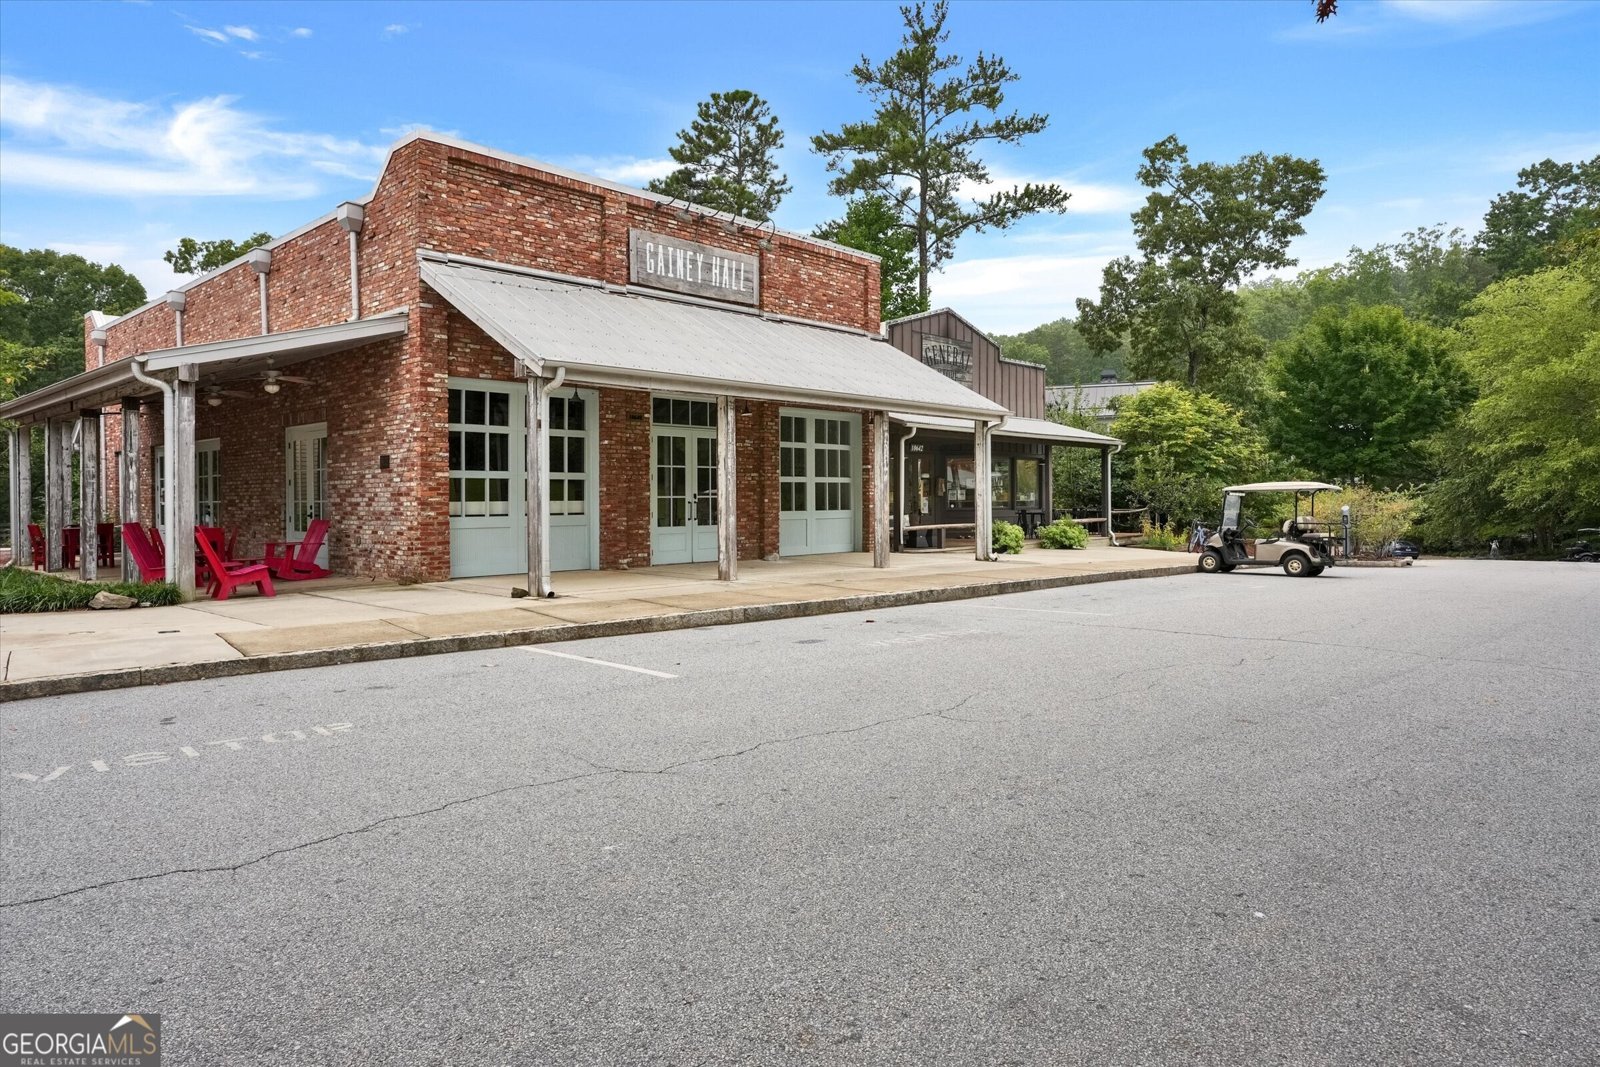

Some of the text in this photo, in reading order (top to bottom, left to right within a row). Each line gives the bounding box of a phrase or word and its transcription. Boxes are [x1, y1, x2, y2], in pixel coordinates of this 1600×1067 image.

[646, 242, 746, 292] GAINEY HALL
[924, 344, 971, 372] GENERAL
